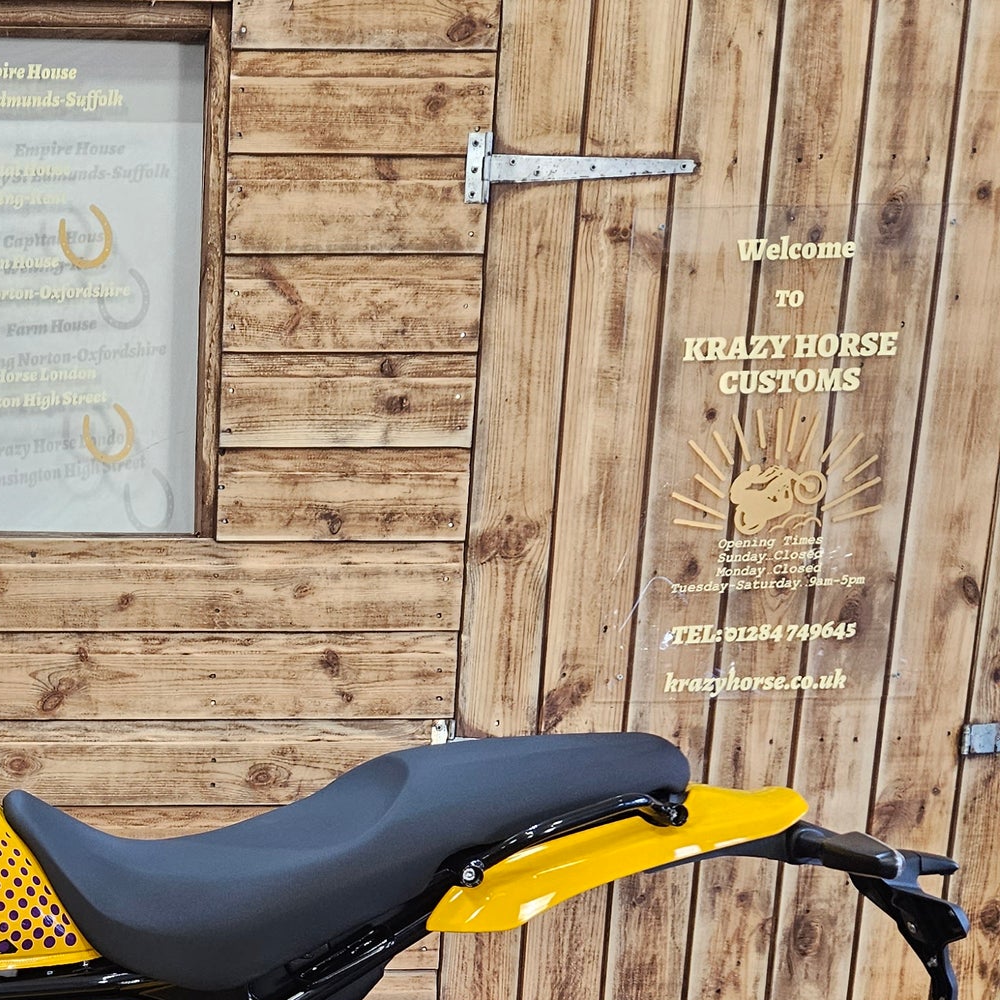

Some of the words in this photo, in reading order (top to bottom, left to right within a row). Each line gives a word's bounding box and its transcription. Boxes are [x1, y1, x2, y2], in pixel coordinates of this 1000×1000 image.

[27, 63, 78, 81] House
[737, 236, 857, 261] Welcome
[11, 256, 61, 270] House
[775, 290, 805, 308] TO
[683, 335, 791, 362] KRAZY
[793, 331, 899, 358] HORSE
[40, 367, 97, 382] London
[719, 367, 862, 395] CUSTOMS
[22, 393, 61, 411] High
[63, 390, 108, 406] Street
[718, 538, 776, 549] Opening
[784, 535, 824, 546] Times
[786, 620, 857, 643] 749645
[664, 667, 847, 697] krazyhorse.co.uk
